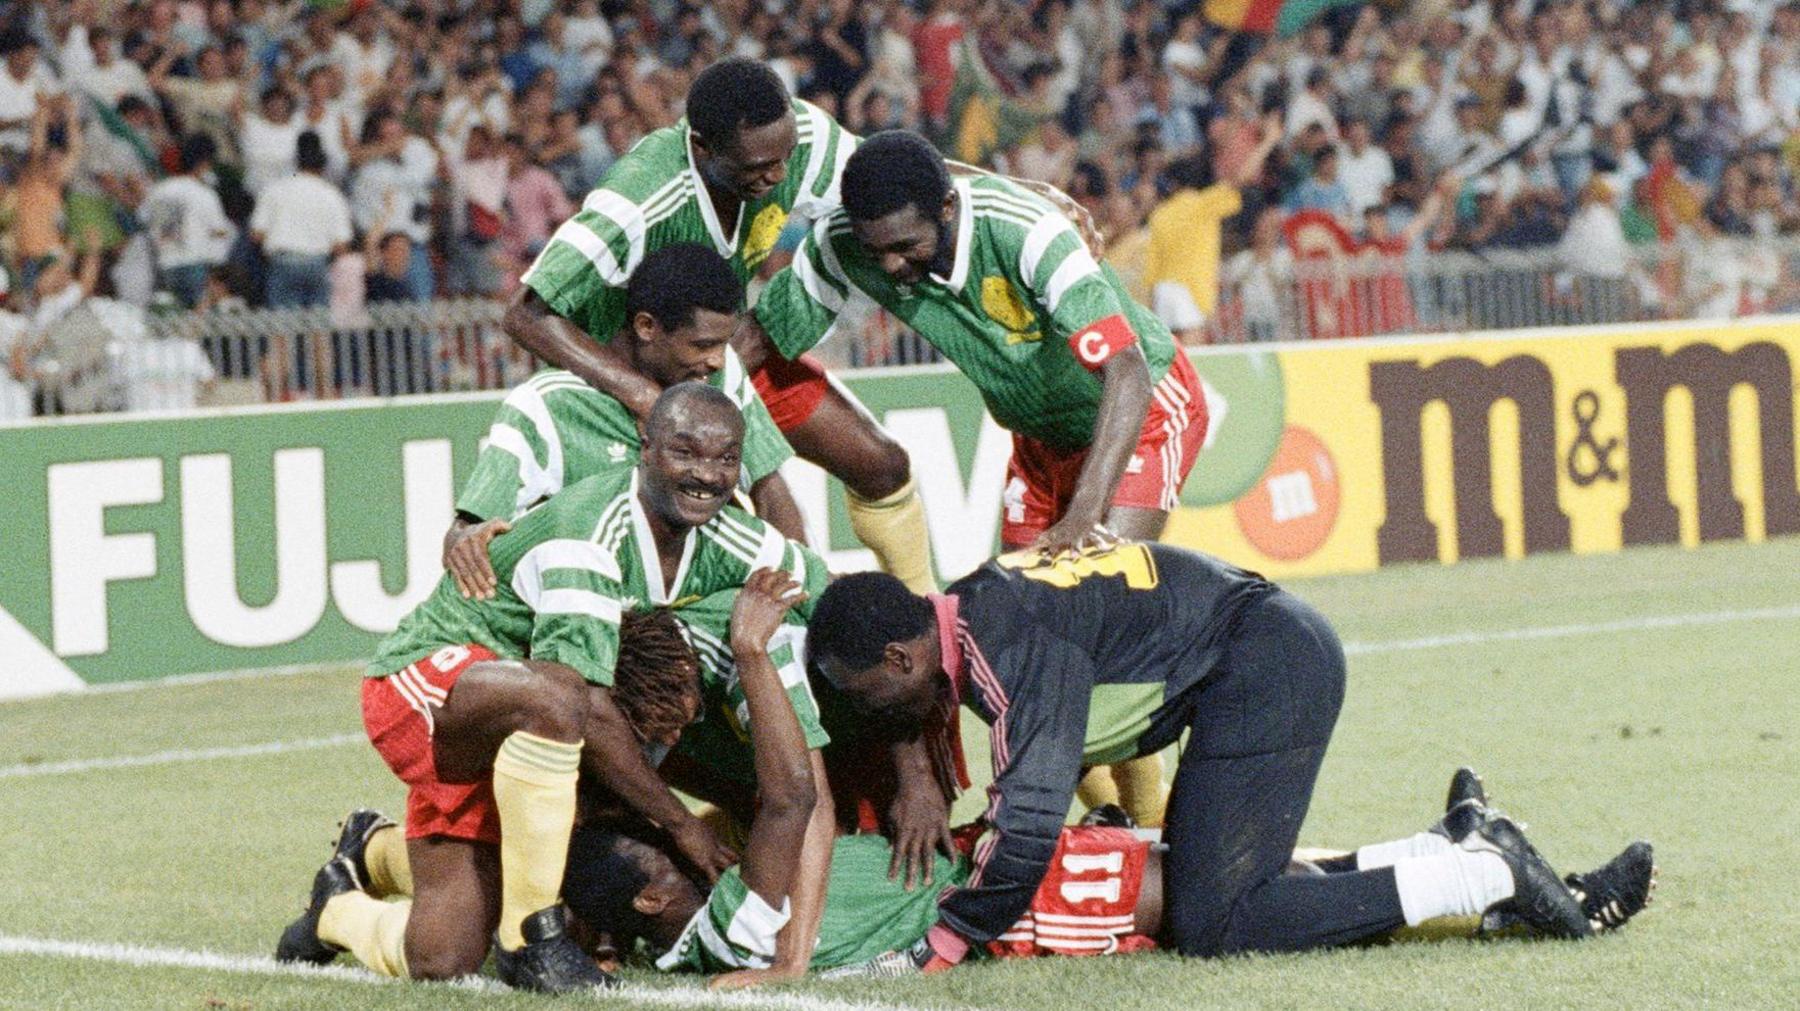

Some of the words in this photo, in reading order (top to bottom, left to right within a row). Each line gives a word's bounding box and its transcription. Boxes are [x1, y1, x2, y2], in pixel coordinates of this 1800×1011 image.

[1079, 332, 1110, 363] C
[47, 436, 490, 657] FUJ
[1061, 852, 1123, 904] 11
